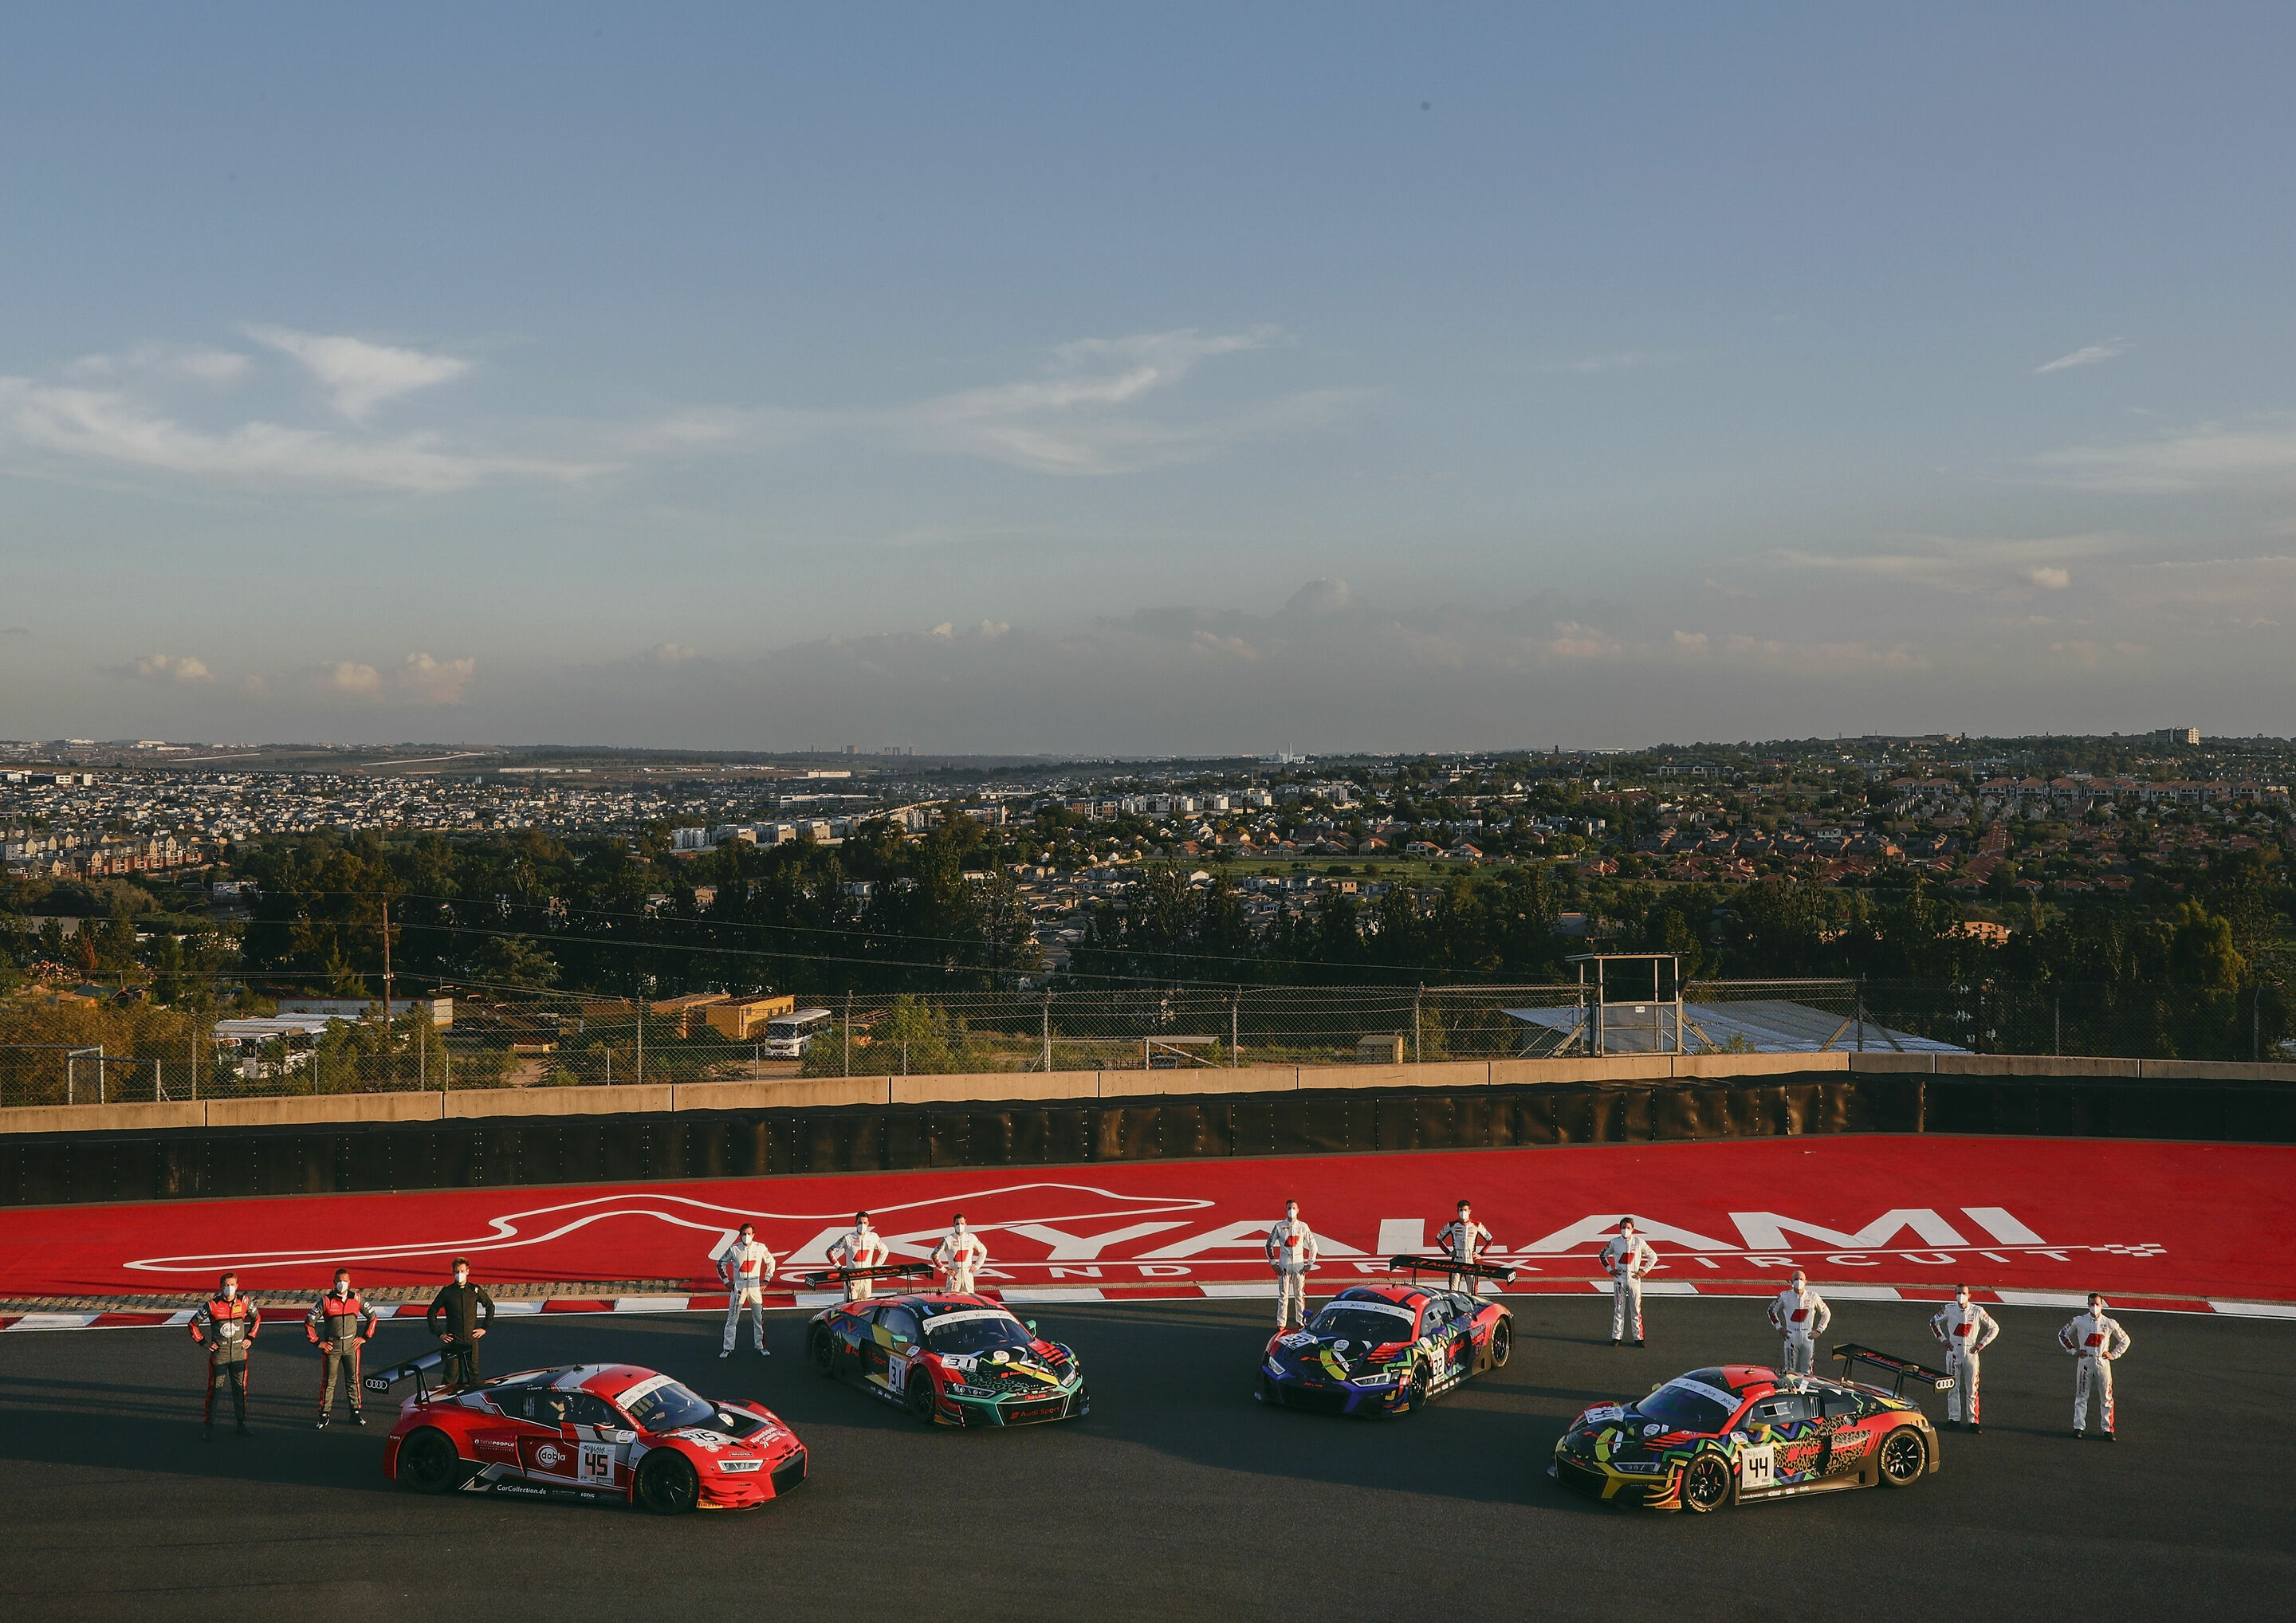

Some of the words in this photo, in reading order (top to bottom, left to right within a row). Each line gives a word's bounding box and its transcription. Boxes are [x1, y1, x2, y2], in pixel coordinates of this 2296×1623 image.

[781, 1206, 2047, 1265] KYALAMI
[780, 1264, 1192, 1283] GAND
[1461, 1264, 1497, 1274] Sprt
[949, 1358, 972, 1368] 31
[1433, 1358, 1443, 1377] 32
[891, 1365, 902, 1389] 31
[1020, 1408, 1038, 1417] Audi
[1040, 1406, 1060, 1416] Sport
[541, 1451, 566, 1461] dobla
[585, 1452, 608, 1476] 45
[1749, 1456, 1768, 1478] 44
[497, 1484, 547, 1495] CarCollection.de
